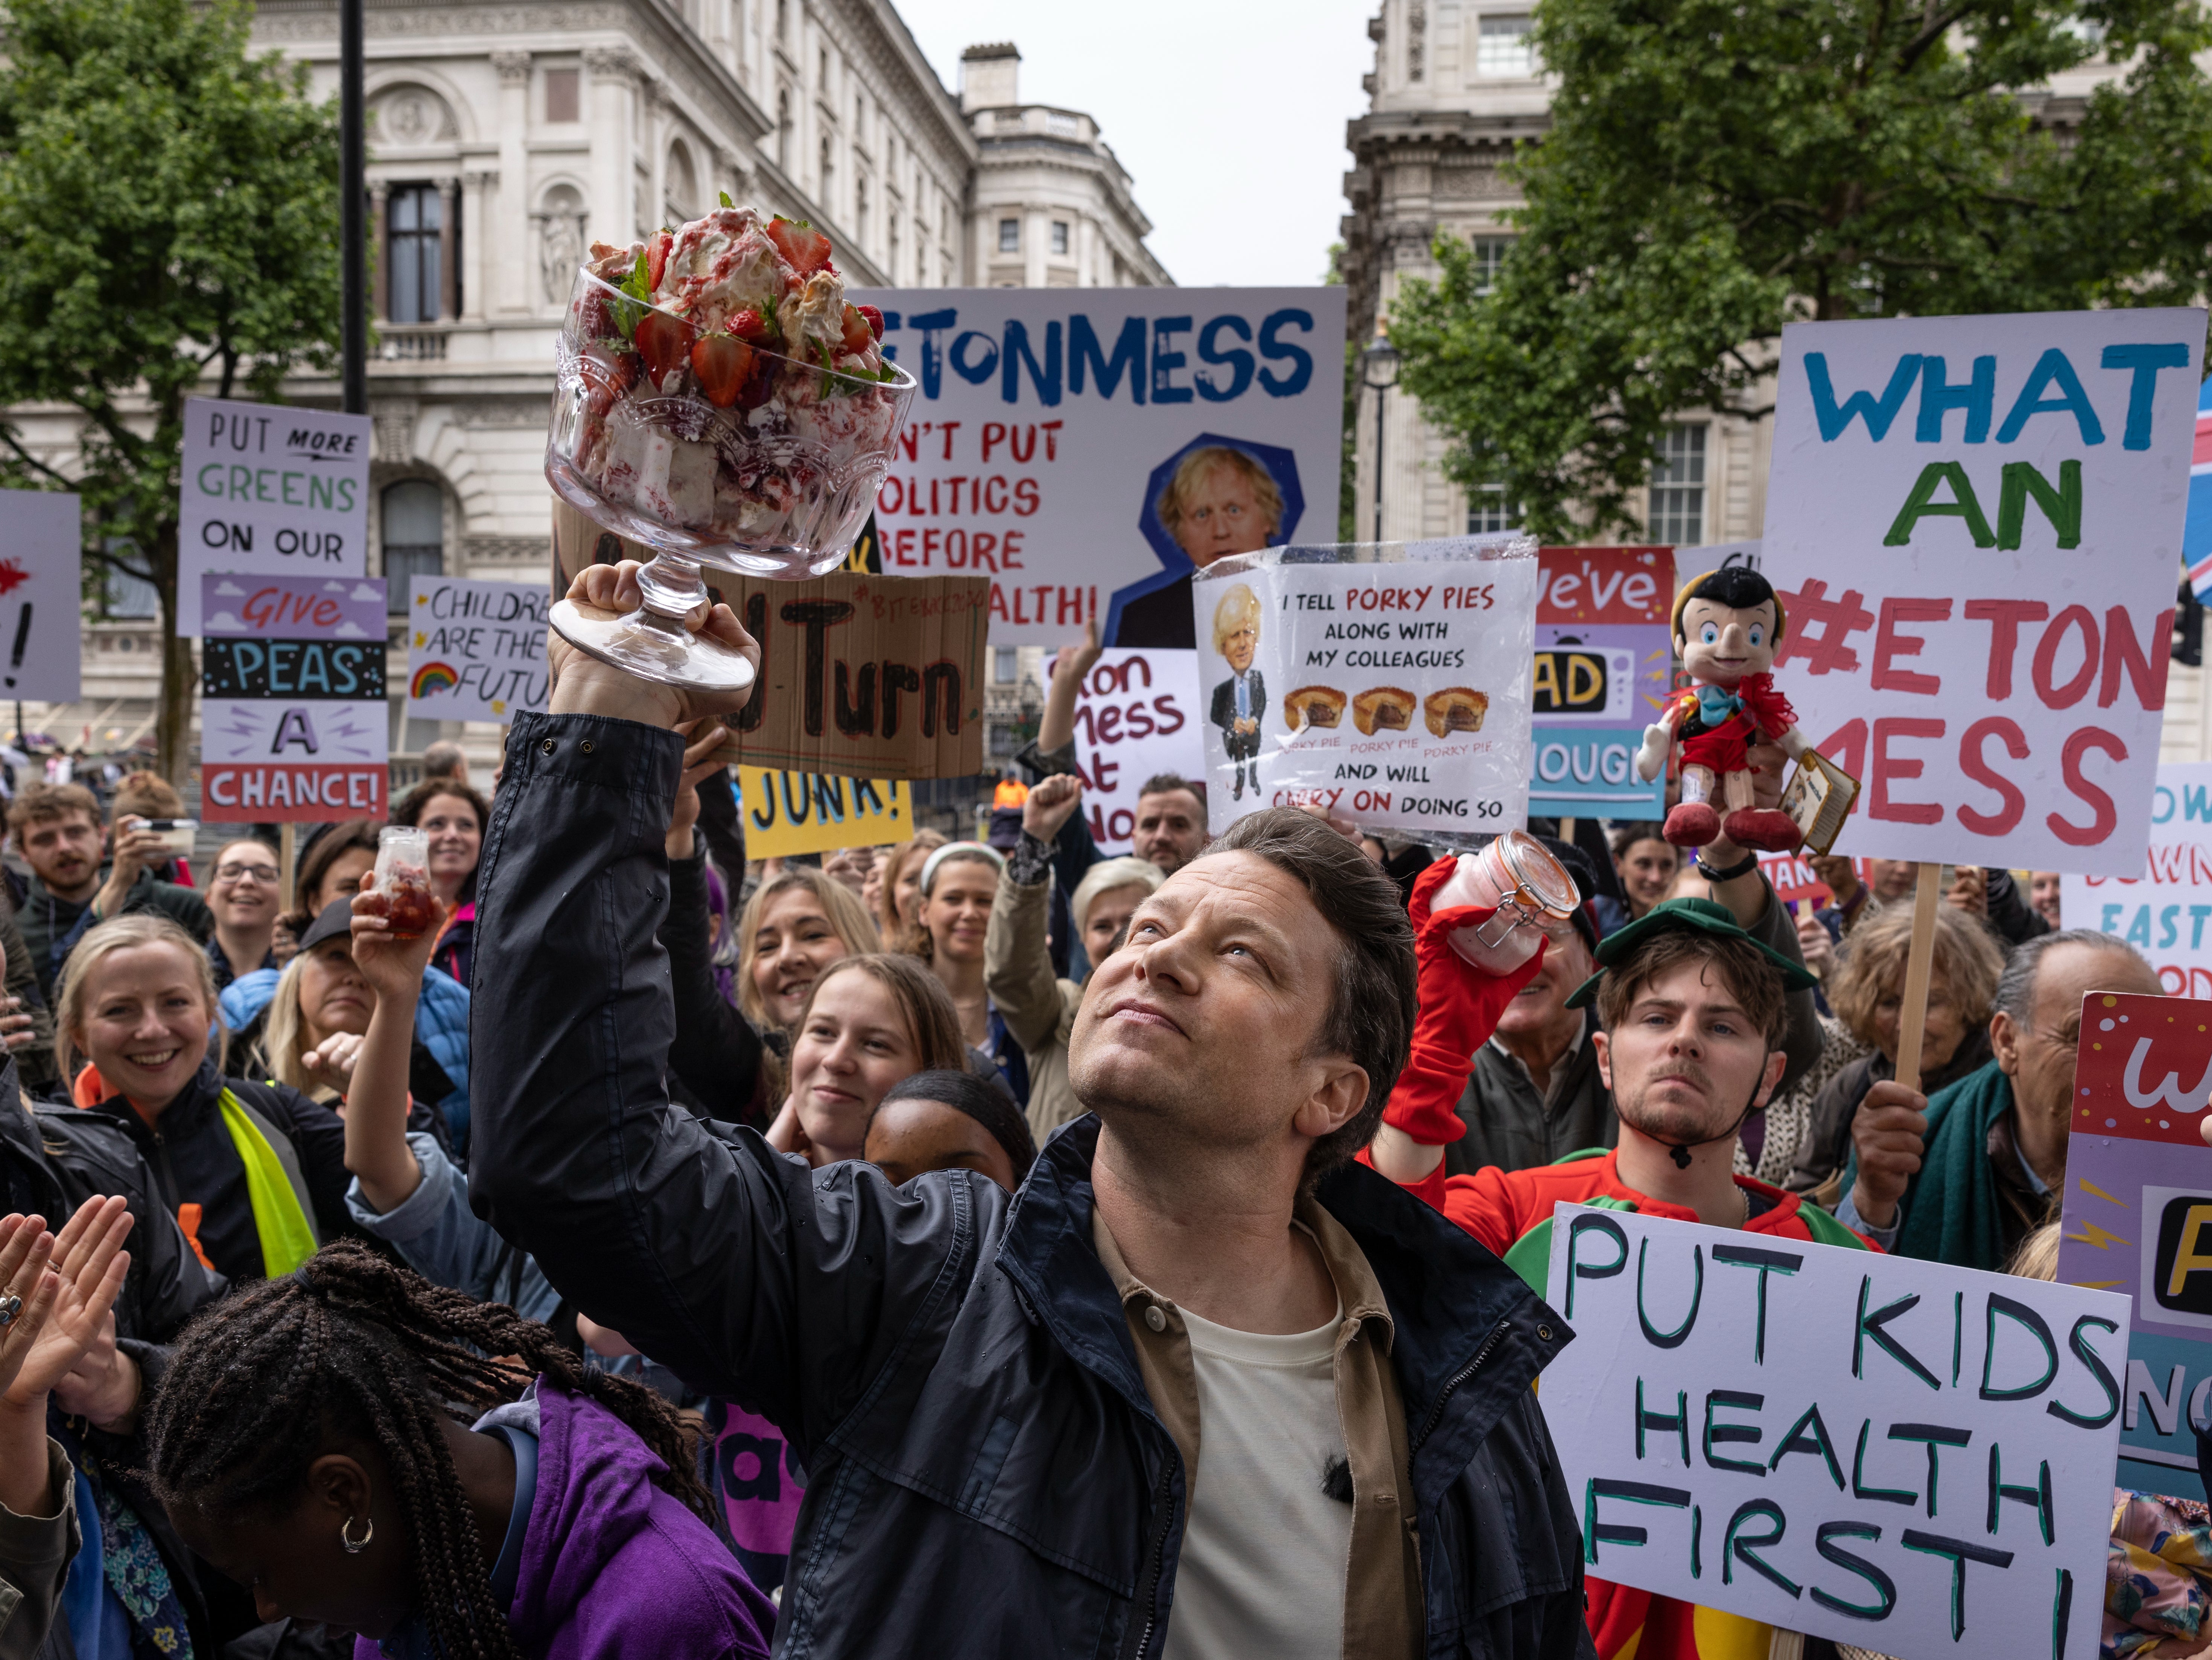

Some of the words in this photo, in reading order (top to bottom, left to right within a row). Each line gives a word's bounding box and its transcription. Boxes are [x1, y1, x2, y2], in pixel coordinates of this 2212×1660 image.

[1803, 342, 2189, 451] WHAT
[211, 413, 271, 452] PUT
[286, 429, 358, 453] MORE
[982, 420, 1063, 463] PUT
[198, 464, 357, 512] GREENS
[1882, 460, 2081, 551] AN
[202, 520, 253, 551] ON
[275, 530, 342, 562] OUR
[1282, 595, 1288, 610] I
[1297, 593, 1335, 610] TELL
[1346, 586, 1433, 612] PORKY
[1443, 584, 1494, 610] PIES
[426, 627, 484, 659] ARE
[494, 628, 548, 660] THE
[1325, 622, 1390, 640] ALONG
[1399, 622, 1448, 639] WITH
[1771, 578, 2175, 711] #ETON
[233, 642, 363, 692] PEAS
[1306, 650, 1338, 666] MY
[1346, 650, 1464, 667] COLLEAGUES
[453, 664, 549, 706] FUTU
[271, 708, 318, 753] A
[1321, 736, 1340, 747] PIE
[1351, 741, 1394, 753] PORKY
[1399, 738, 1418, 749] PIE
[1424, 744, 1468, 758] PORKY
[1335, 763, 1377, 779] AND
[1386, 765, 1430, 782] WILL
[1530, 741, 1655, 787] OUG
[209, 770, 378, 813] CHANCE!
[752, 771, 899, 831] JUNK!
[1354, 790, 1391, 812] ON
[1401, 797, 1468, 817] DOING
[1477, 799, 1502, 818] SO
[1565, 1214, 1804, 1365] PUT
[1852, 1274, 2120, 1429] KIDS
[1636, 1375, 2055, 1546] HEALTH
